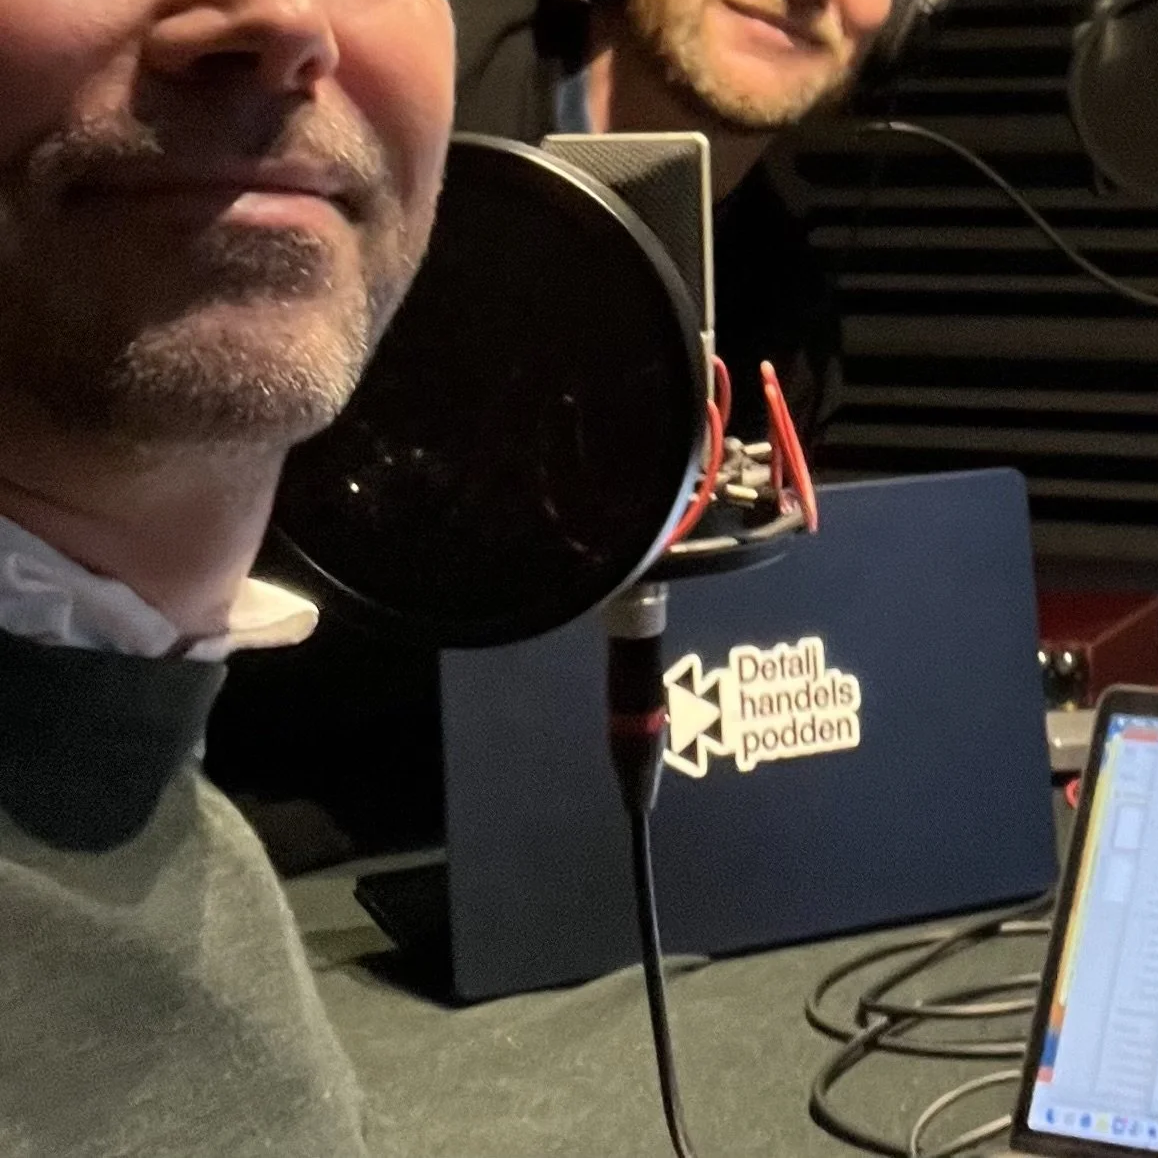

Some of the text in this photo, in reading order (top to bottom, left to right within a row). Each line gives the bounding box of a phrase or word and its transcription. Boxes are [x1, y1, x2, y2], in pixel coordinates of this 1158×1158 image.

[738, 645, 819, 683] Detalj
[740, 677, 854, 720] handels
[742, 714, 853, 761] podden
